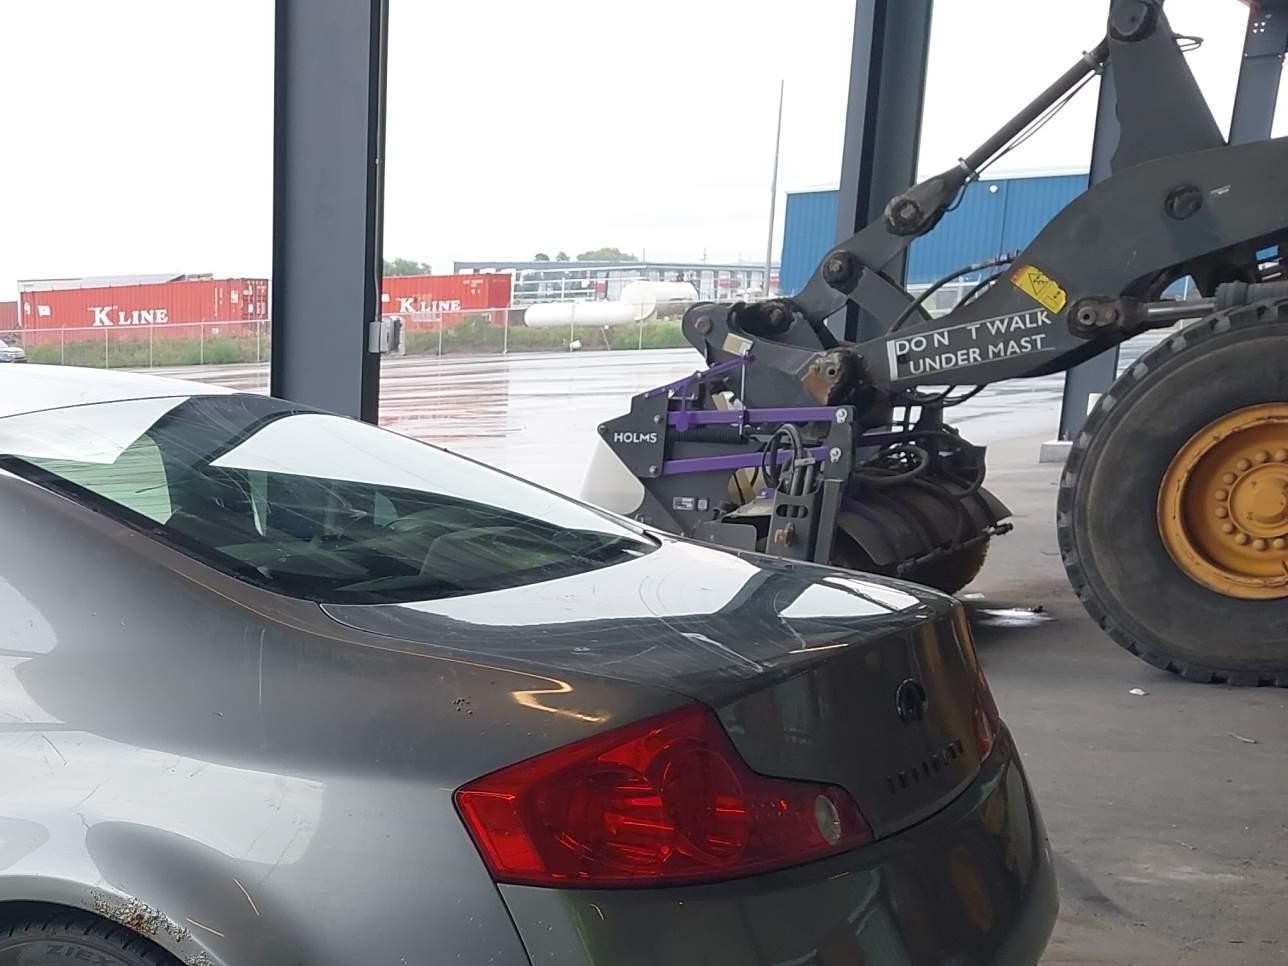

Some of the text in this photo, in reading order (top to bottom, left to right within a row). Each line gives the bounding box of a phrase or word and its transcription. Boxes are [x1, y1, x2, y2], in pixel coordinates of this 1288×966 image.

[420, 299, 461, 313] LINE
[118, 309, 169, 325] LINE
[987, 310, 1052, 336] WALK
[909, 333, 1046, 374] UNDER MAST
[613, 432, 657, 443] HOLMS
